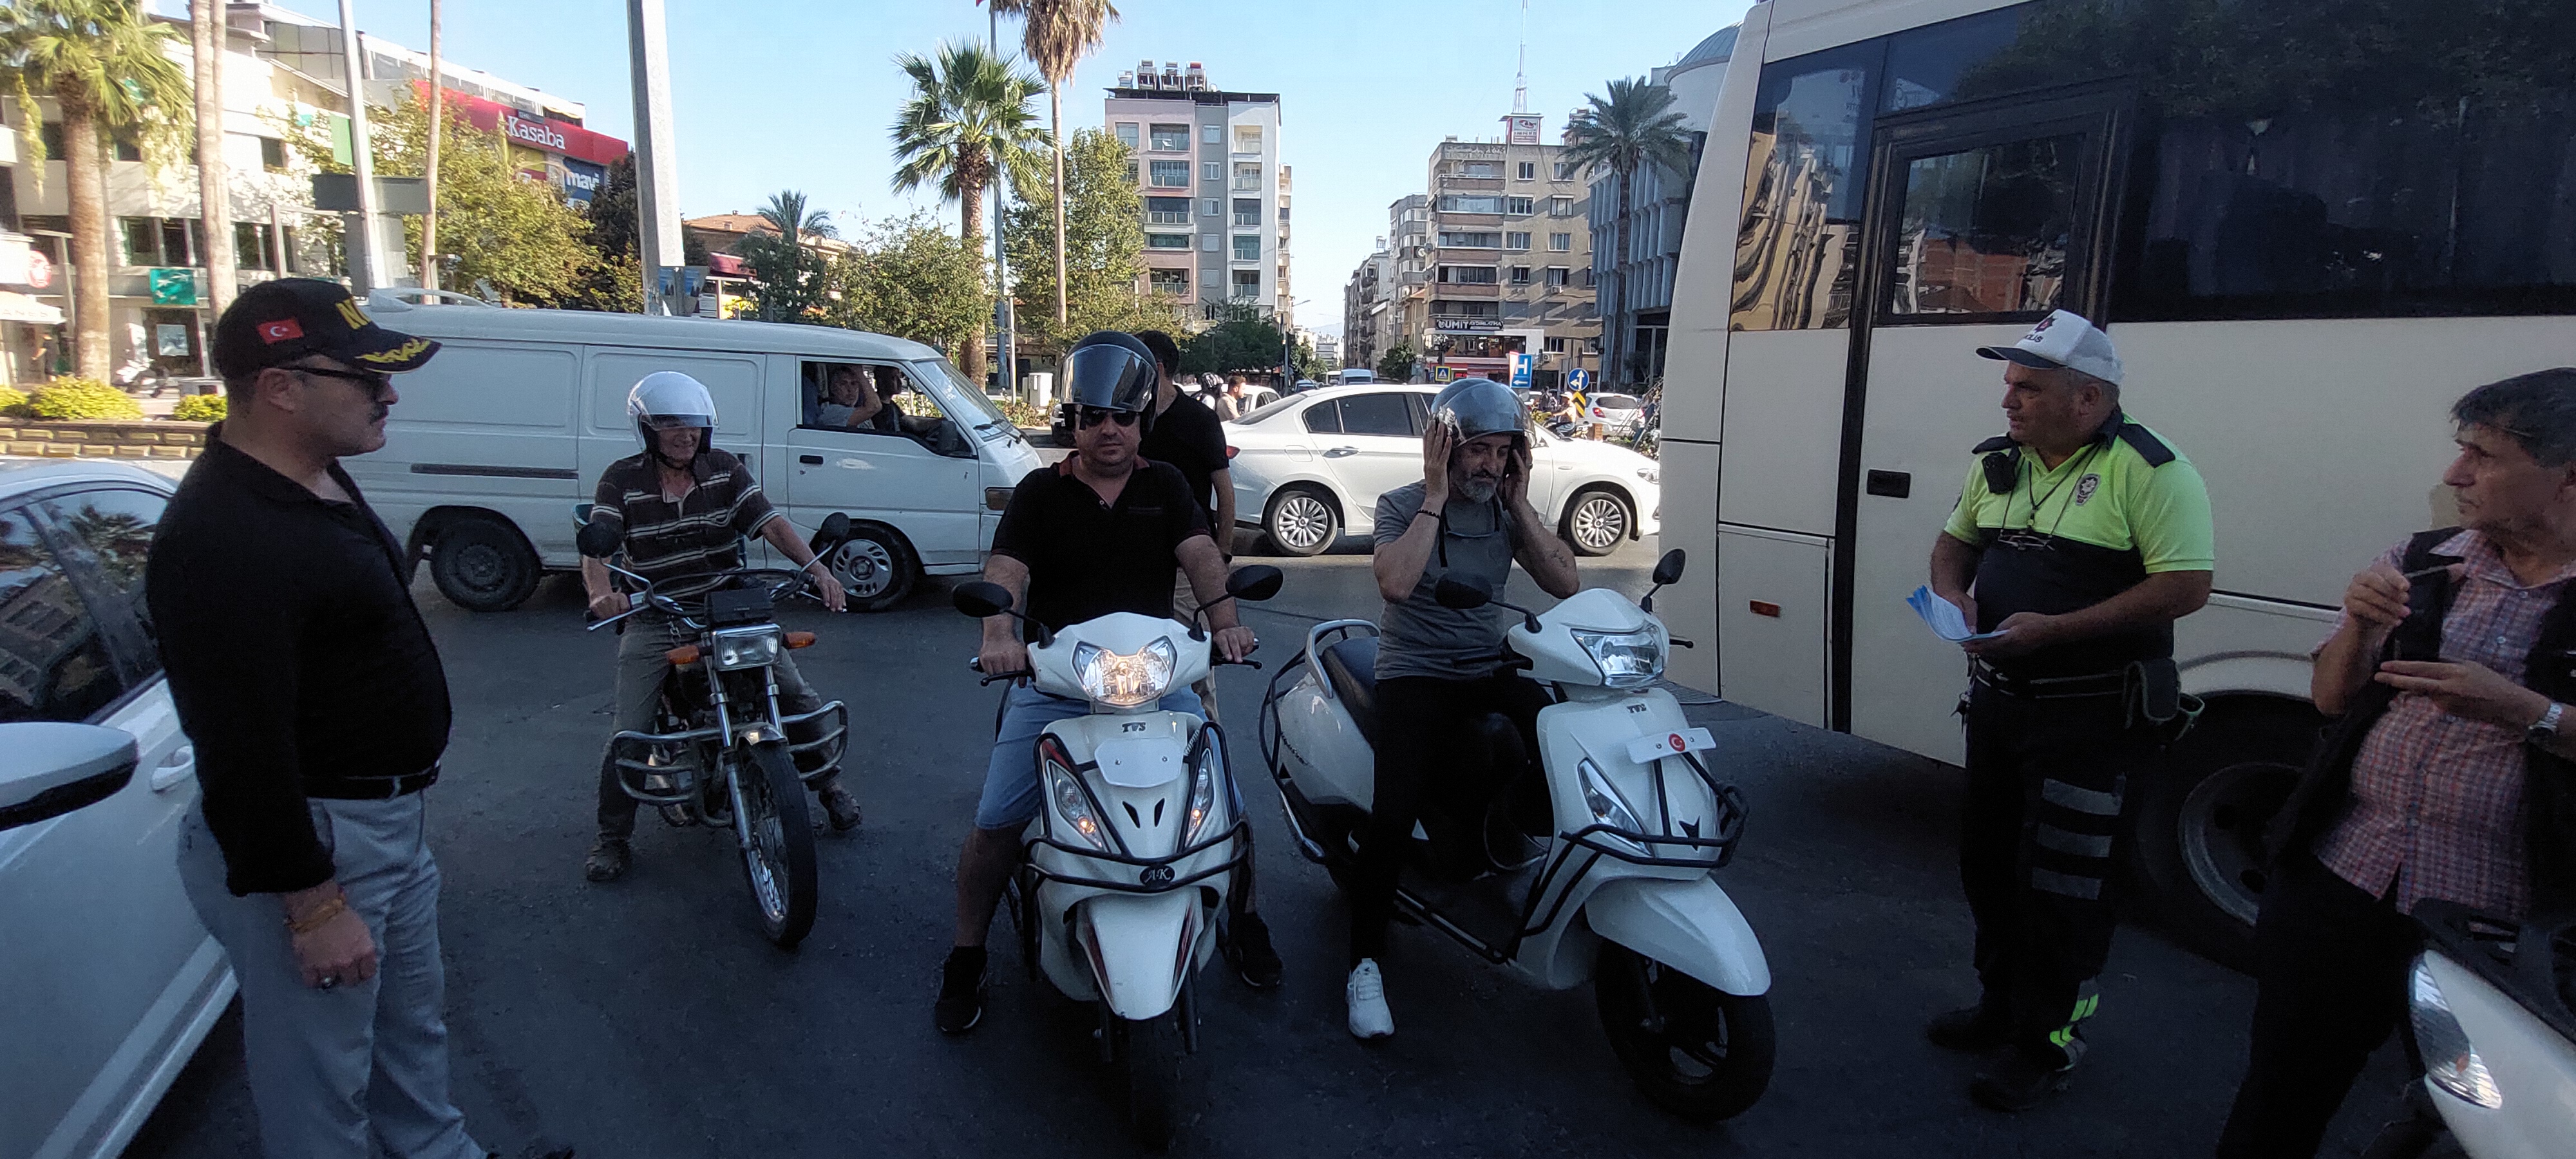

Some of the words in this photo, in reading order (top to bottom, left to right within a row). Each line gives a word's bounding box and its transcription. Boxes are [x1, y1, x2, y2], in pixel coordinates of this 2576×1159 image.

[507, 115, 565, 150] Kasaba
[567, 172, 600, 191] mavi
[2023, 334, 2043, 343] OLIS
[1626, 703, 1647, 713] TVS
[1122, 722, 1146, 733] TVS
